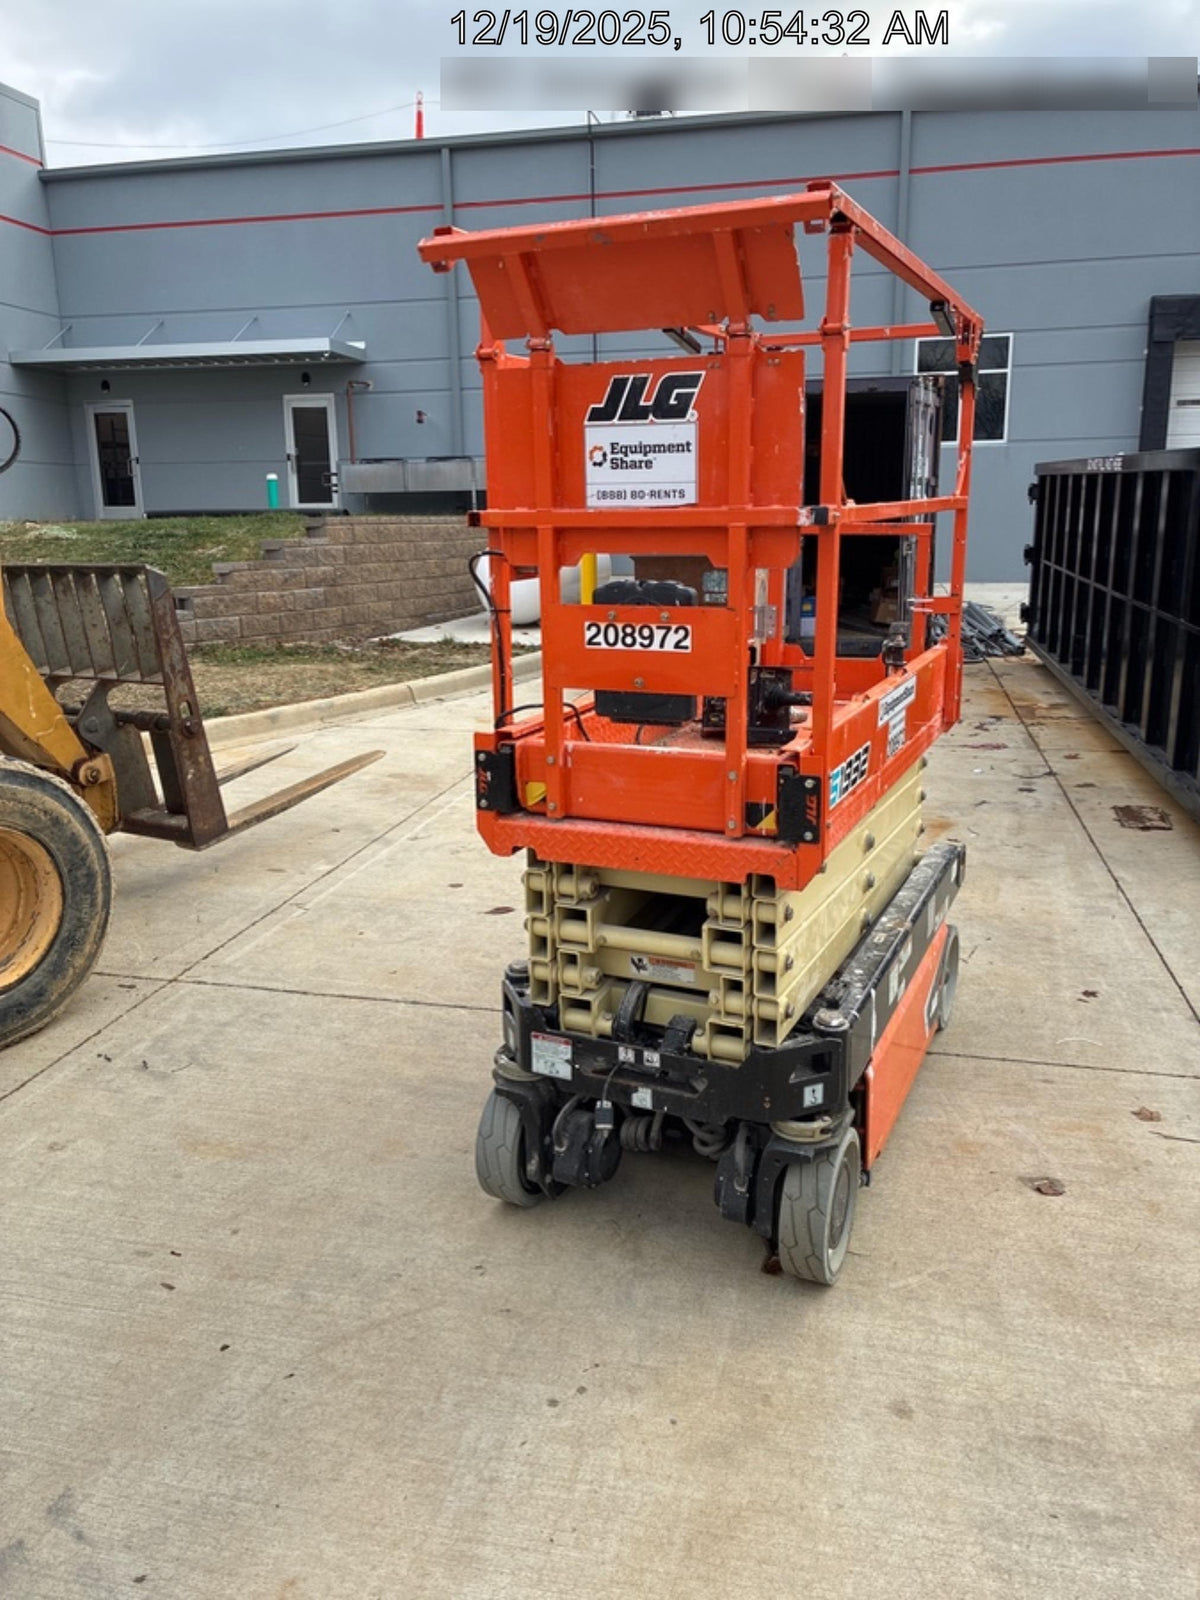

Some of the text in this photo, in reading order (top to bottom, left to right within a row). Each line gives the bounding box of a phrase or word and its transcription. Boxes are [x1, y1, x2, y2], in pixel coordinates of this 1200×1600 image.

[586, 372, 704, 422] JLG
[610, 440, 692, 458] Equipment
[610, 457, 653, 470] Share
[585, 622, 690, 651] 208972
